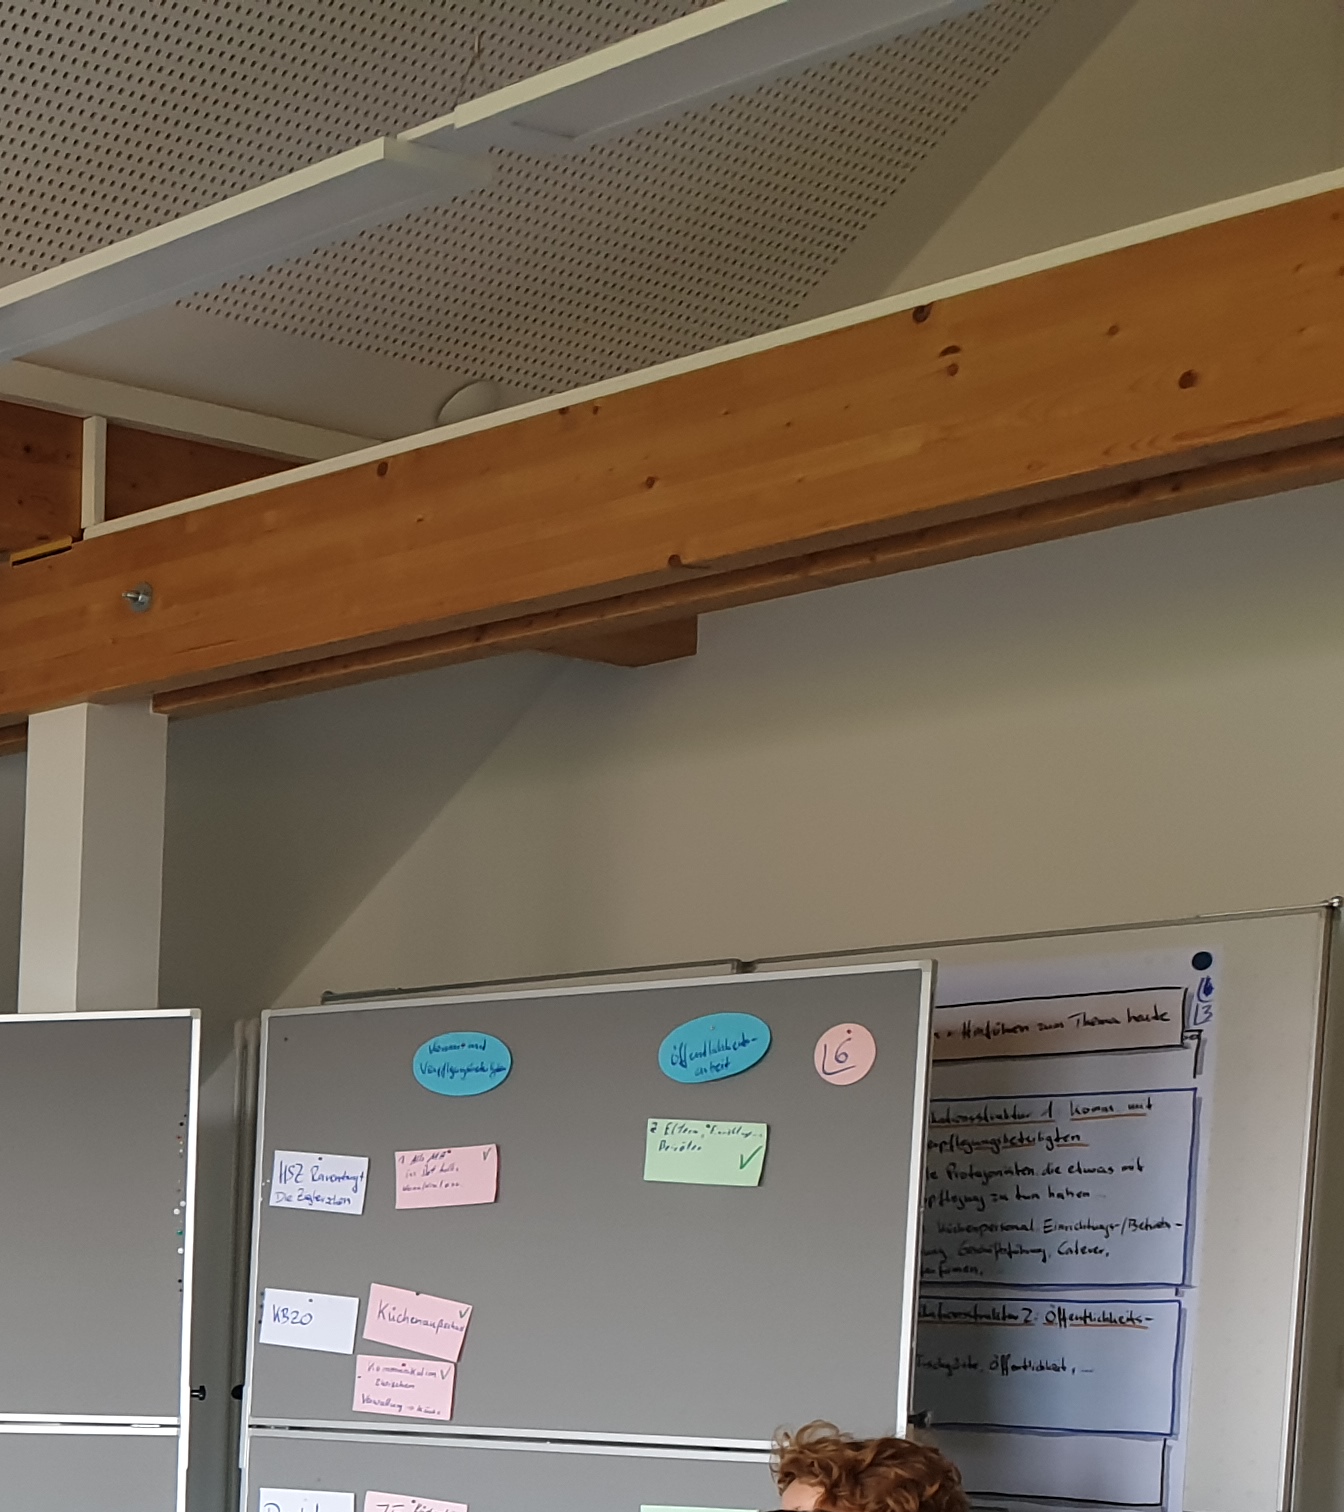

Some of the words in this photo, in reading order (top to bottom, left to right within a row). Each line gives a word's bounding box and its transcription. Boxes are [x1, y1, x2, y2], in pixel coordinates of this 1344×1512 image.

[1067, 1012, 1121, 1028] Thema
[1126, 1003, 1171, 1023] heute
[279, 1160, 303, 1184] HSZ
[1067, 1161, 1114, 1176] etwas
[275, 1192, 293, 1203] Die
